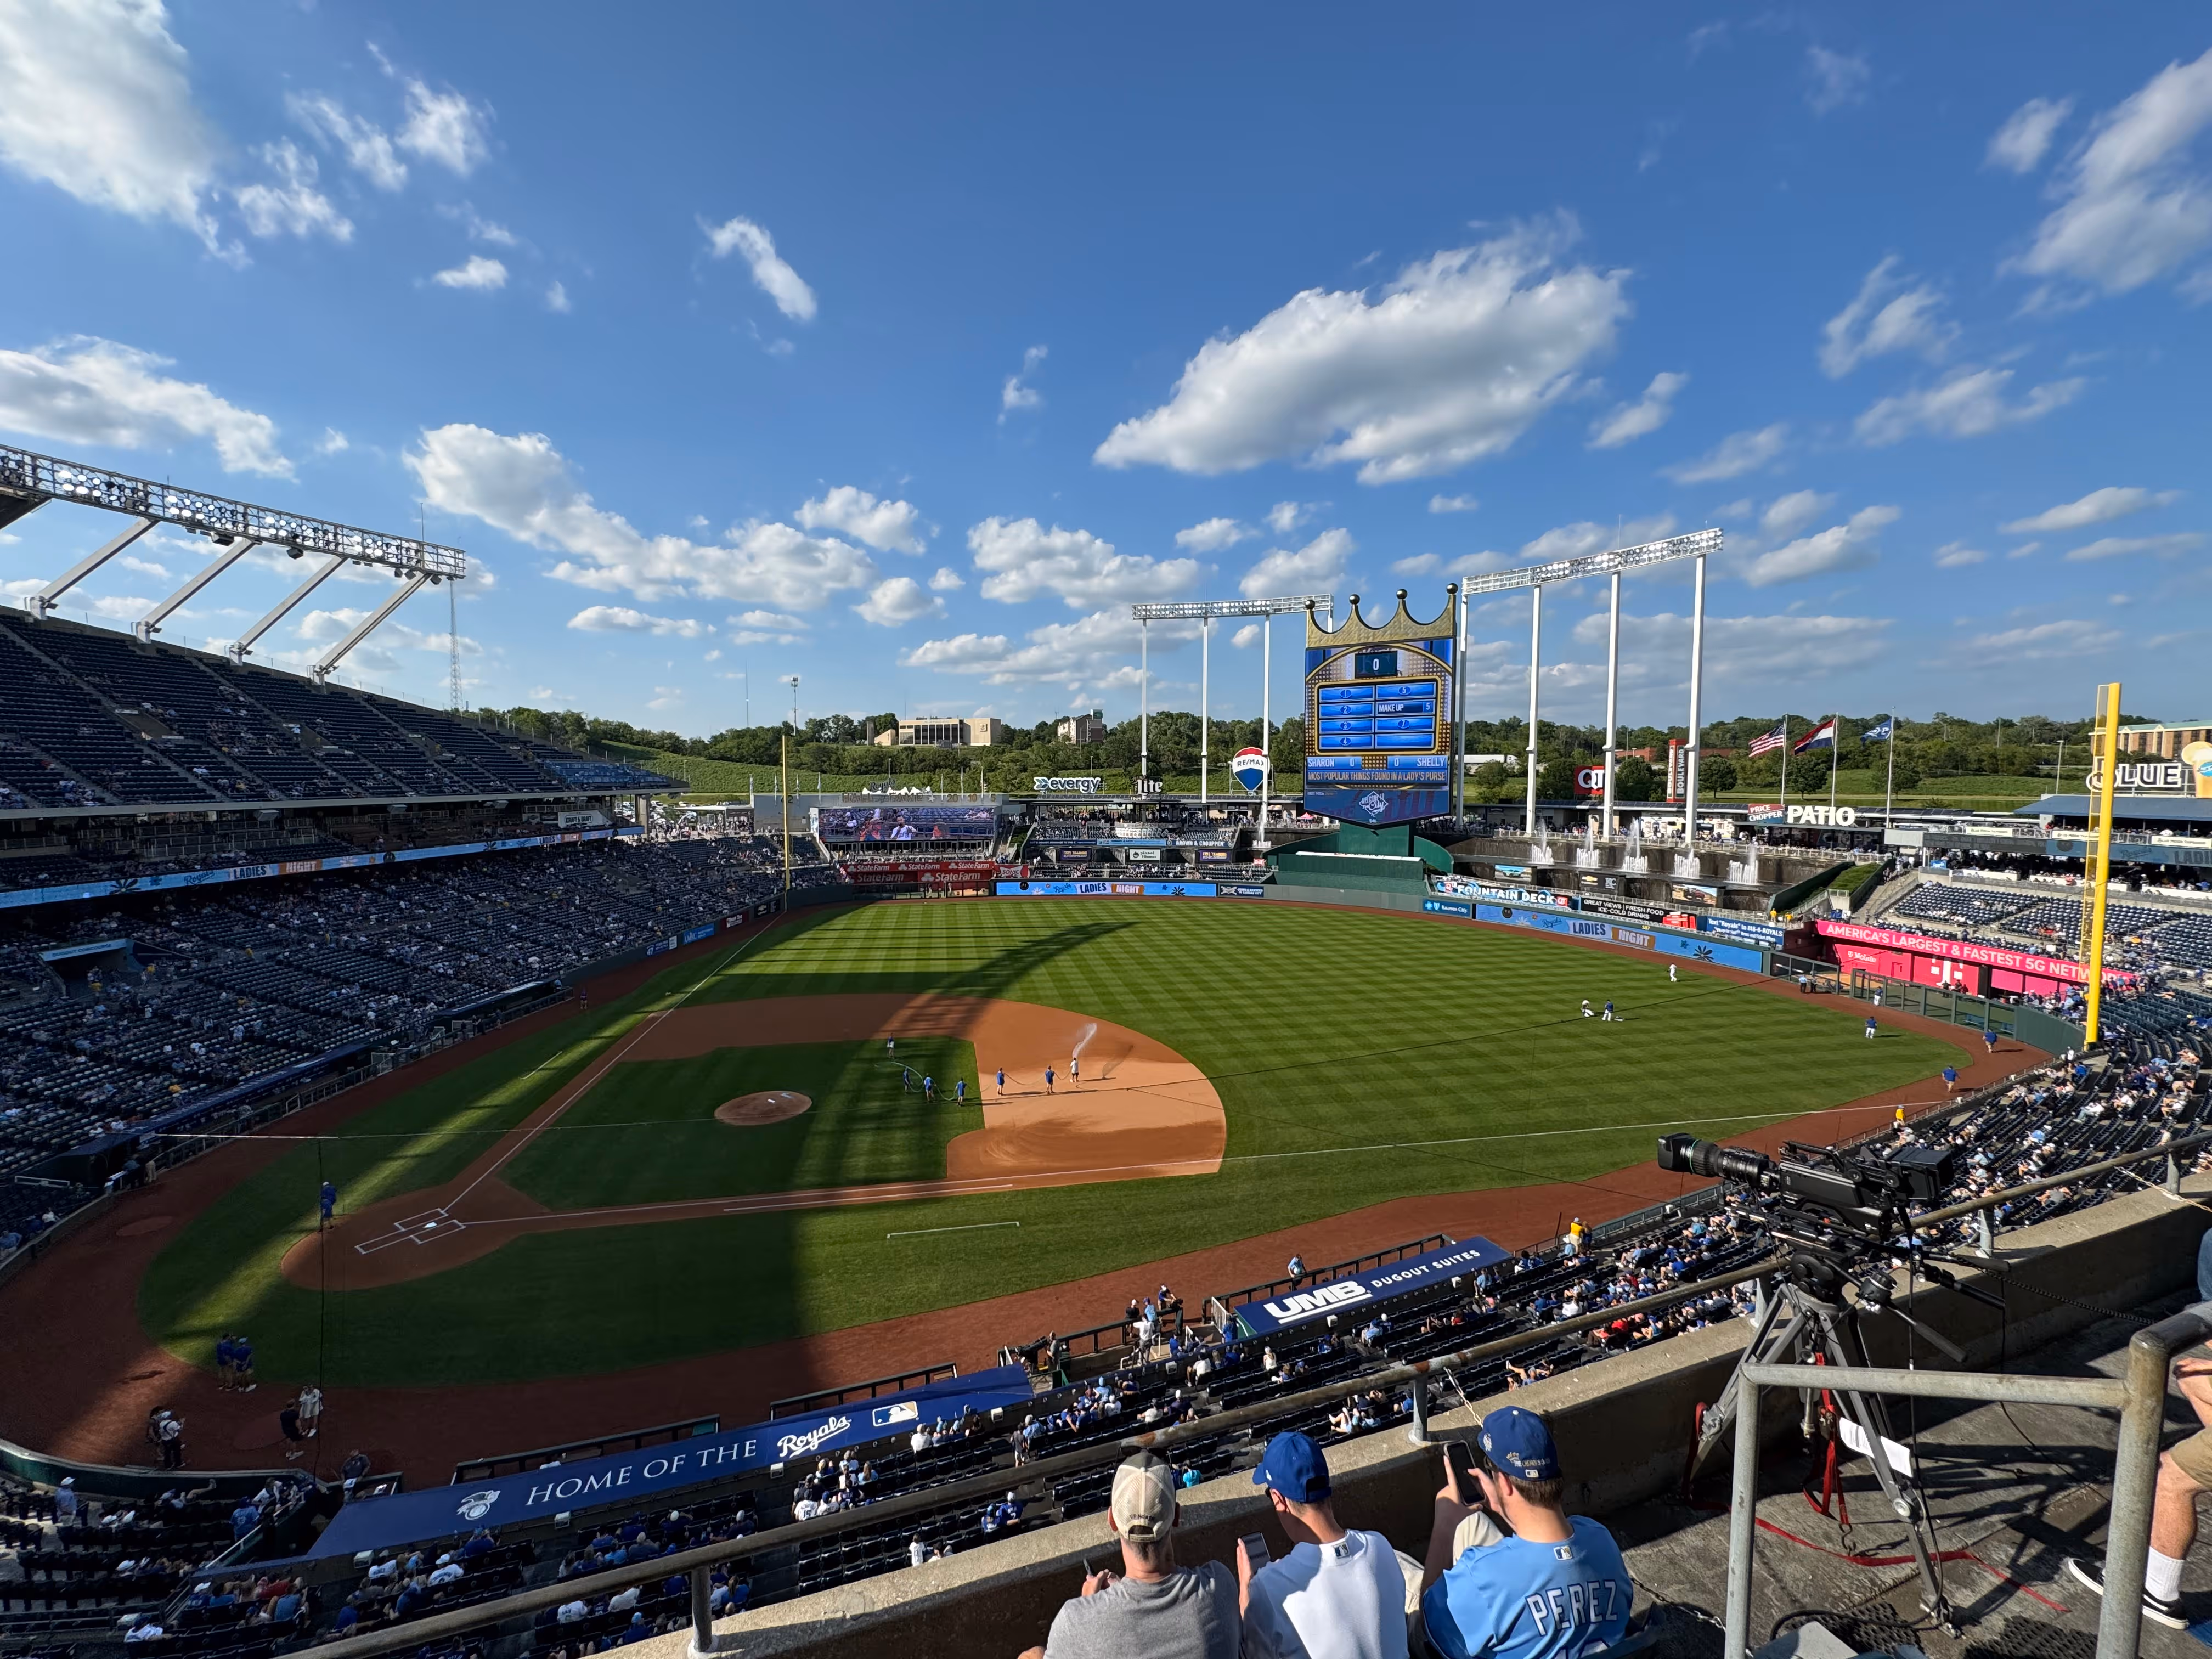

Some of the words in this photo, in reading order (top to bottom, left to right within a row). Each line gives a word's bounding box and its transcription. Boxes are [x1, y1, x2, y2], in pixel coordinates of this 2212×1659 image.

[1373, 658, 1379, 671] 0
[1344, 690, 1347, 698] 1
[1402, 686, 1407, 694] 5
[1426, 702, 1430, 710] 5
[1308, 758, 1335, 767] SHARON
[1350, 758, 1355, 767] 0
[1394, 757, 1400, 766] 0
[1417, 757, 1445, 766] SHELLY
[1308, 772, 1323, 780] MOST
[1324, 772, 1349, 780] POPULAR
[1351, 771, 1370, 780] THINGS
[1372, 771, 1390, 780] FOUND
[1391, 771, 1397, 780] IN
[1398, 771, 1402, 780] A
[1403, 771, 1424, 780] LADY'S
[1426, 771, 1445, 780] PURSE
[1677, 748, 1685, 794] BOULEVARD
[1050, 778, 1099, 792] evergy
[1578, 769, 1604, 789] QT
[1137, 779, 1163, 795] Lite
[947, 794, 958, 803] 20
[968, 794, 977, 803] 10
[1749, 811, 1783, 821] CHOPPER
[1787, 805, 1855, 826] PATIO
[234, 865, 267, 879] LADIES
[286, 860, 317, 873] NIGHT
[935, 872, 980, 881] StateFarm
[1054, 883, 1071, 893] Royals
[1080, 883, 1107, 893] LADIES
[1116, 885, 1140, 894] NIGHT
[1458, 885, 1519, 901] FOUNTAIN
[1522, 893, 1555, 905] DECK
[1598, 907, 1626, 915] ICE-COLD
[1572, 922, 1606, 936] LADIES
[1618, 929, 1650, 946] NIGHT
[1826, 924, 1889, 944] AMERICA'S
[1892, 934, 1949, 953] LARGEST
[1951, 946, 1960, 956] &
[1963, 947, 2022, 967] FASTEST
[2025, 958, 2046, 971] 5G
[1370, 1265, 1430, 1288] DUGOUT
[1431, 1249, 1481, 1268] SUITES
[1263, 1280, 1368, 1318] UMB
[526, 1466, 633, 1506] HOME
[643, 1453, 685, 1479] OF
[696, 1439, 757, 1467] THE
[777, 1415, 852, 1458] Royals
[803, 1510, 811, 1518] 15
[1526, 1580, 1618, 1636] PEREZ
